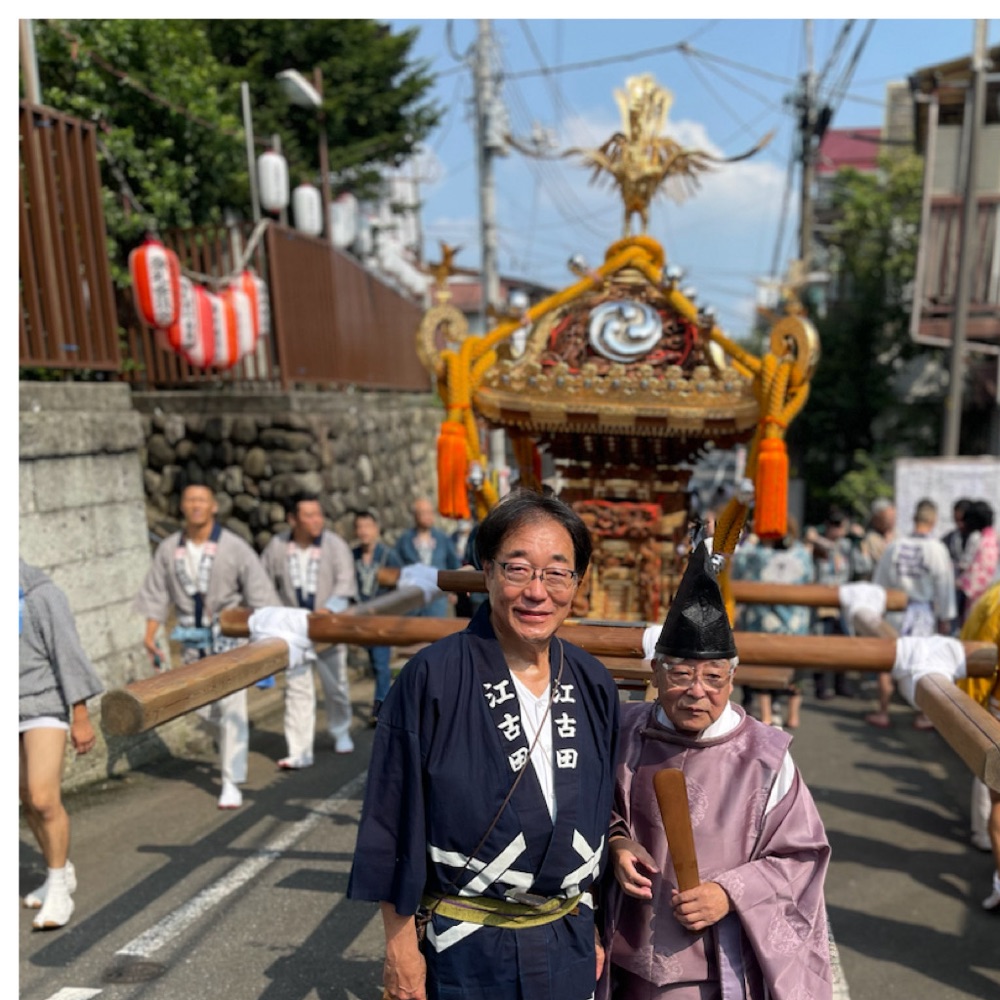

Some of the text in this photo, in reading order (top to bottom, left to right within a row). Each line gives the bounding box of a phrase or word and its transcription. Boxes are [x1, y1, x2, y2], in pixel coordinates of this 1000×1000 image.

[483, 680, 529, 772] 江古田
[552, 679, 579, 769] 江古田
